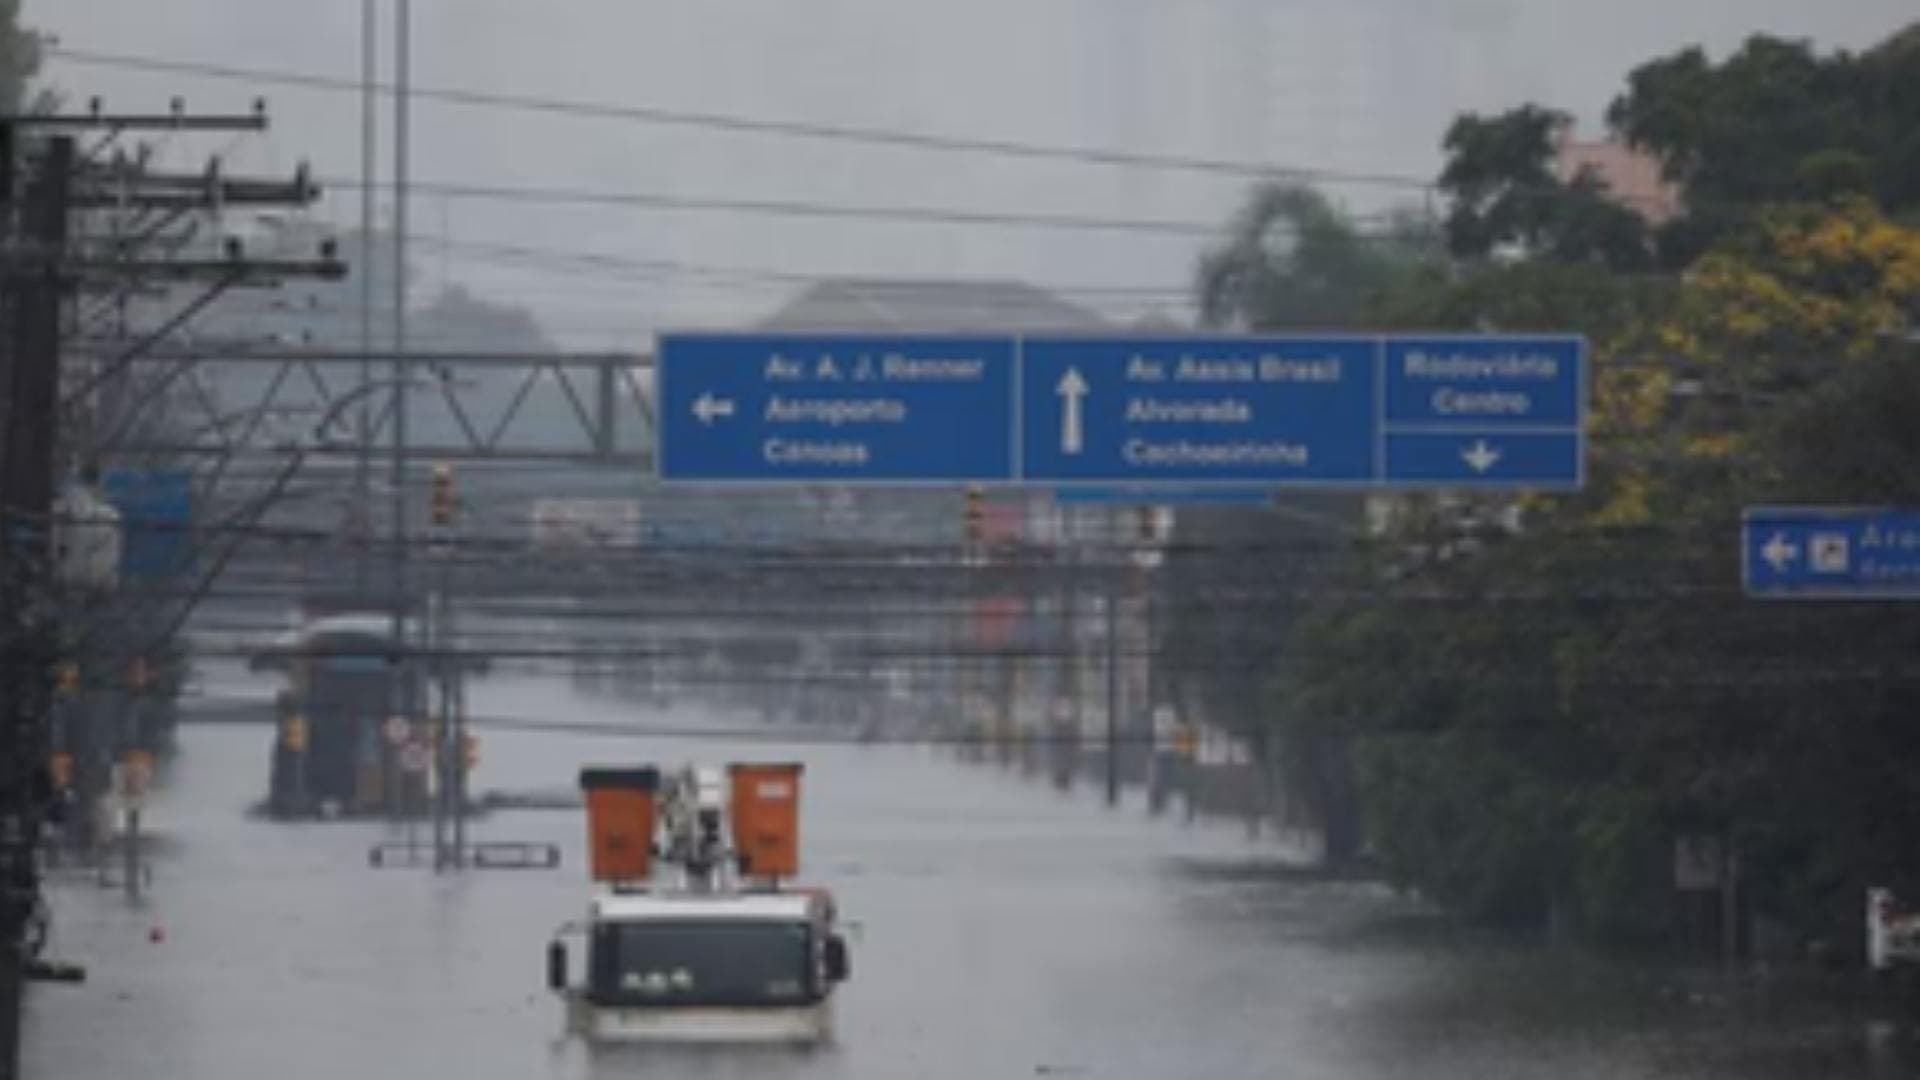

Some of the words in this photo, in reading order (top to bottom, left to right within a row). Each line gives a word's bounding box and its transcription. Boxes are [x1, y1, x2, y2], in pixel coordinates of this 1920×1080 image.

[884, 355, 983, 378] Renner
[1175, 355, 1253, 379] Assis
[1260, 355, 1340, 379] Brasil
[766, 397, 905, 424] Aeroporto
[1127, 398, 1250, 420] Alvorada
[1431, 388, 1529, 412] Centro
[765, 439, 868, 463] Canoas
[1124, 439, 1307, 464] Cachoeirinha
